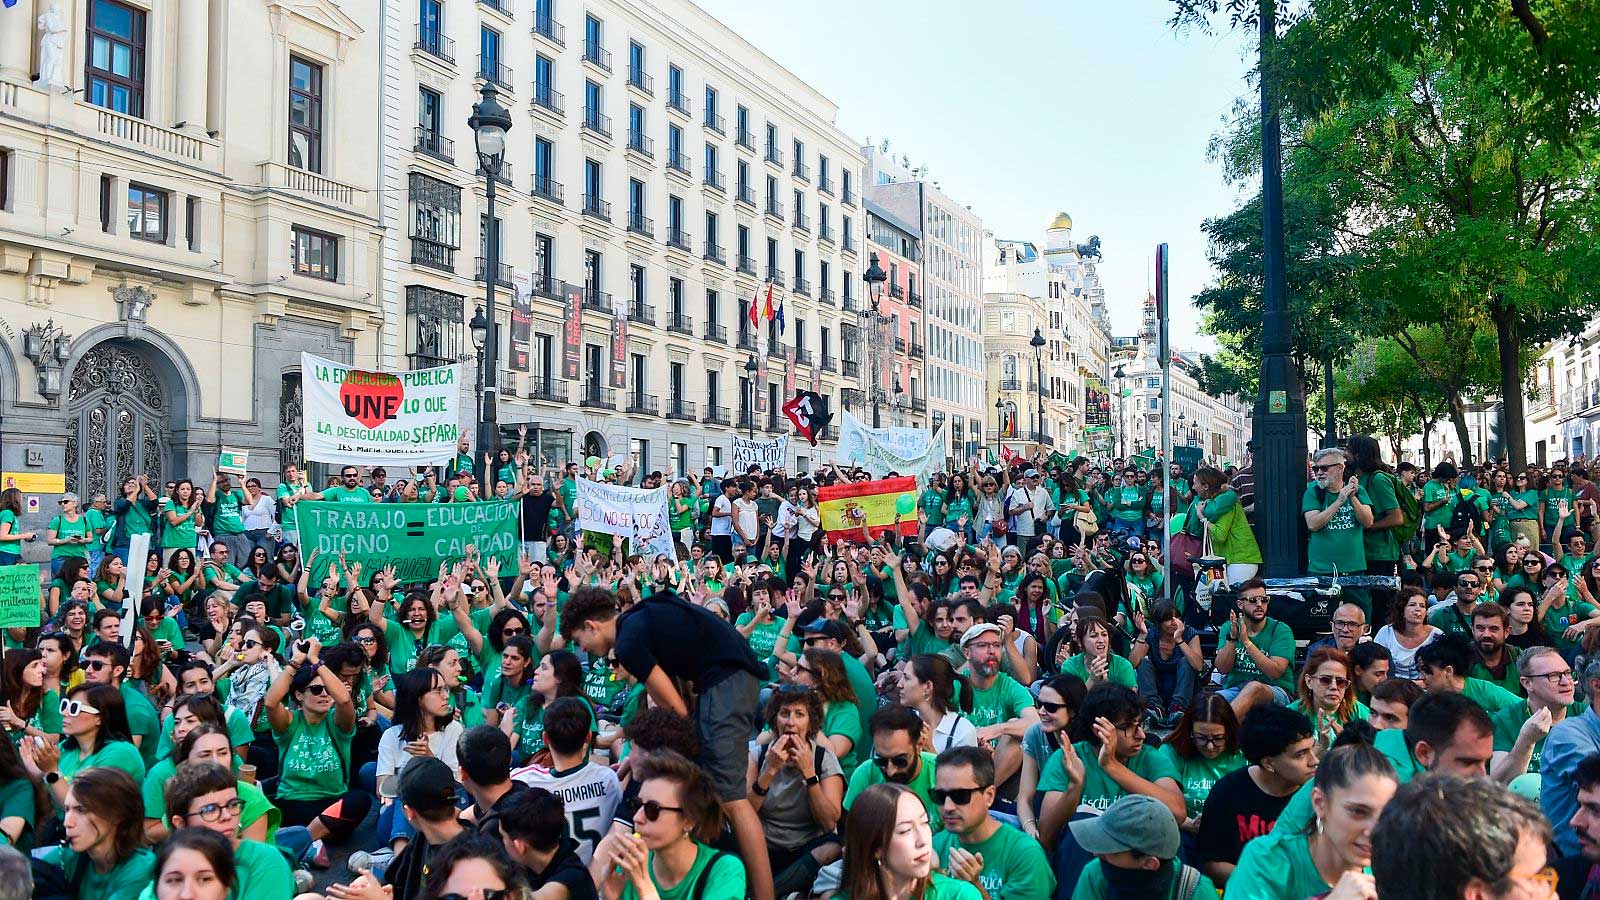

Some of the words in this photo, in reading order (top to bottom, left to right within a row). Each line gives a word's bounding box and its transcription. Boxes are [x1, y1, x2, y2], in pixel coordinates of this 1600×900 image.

[316, 365, 329, 383] LA
[344, 394, 398, 420] UNE
[404, 398, 420, 414] LO
[424, 396, 448, 413] QUE
[317, 421, 333, 436] LA
[337, 426, 410, 443] DESIGUALDAD
[411, 422, 457, 445] SEPARA
[30, 452, 44, 463] 34
[311, 509, 406, 529] TRABAJO
[427, 502, 520, 527] EDUCACIÓN
[604, 511, 618, 526] NO
[471, 525, 483, 533] DE
[319, 533, 390, 555] DIGNO
[435, 532, 514, 557] CALIDAD
